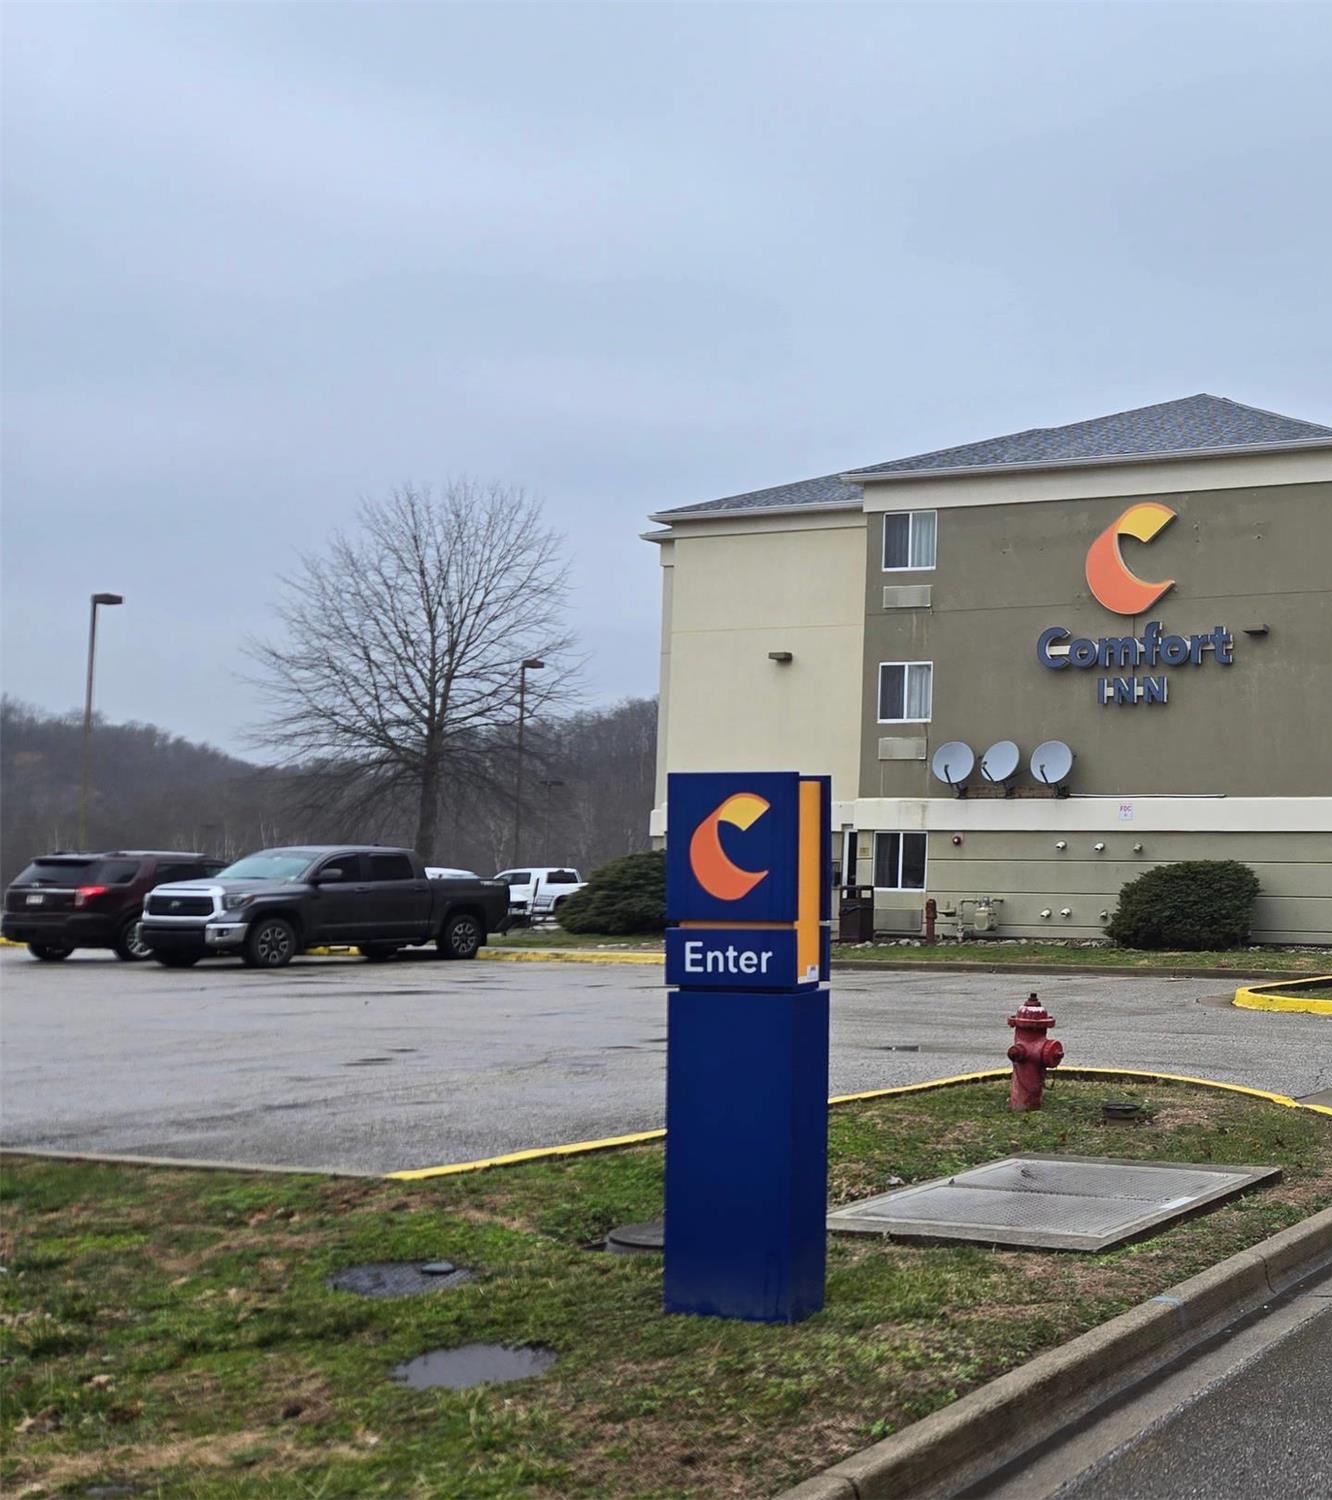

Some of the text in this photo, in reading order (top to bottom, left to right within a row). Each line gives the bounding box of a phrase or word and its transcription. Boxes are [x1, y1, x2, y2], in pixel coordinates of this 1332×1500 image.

[1037, 621, 1234, 670] Comfort
[1097, 676, 1168, 704] INN
[684, 941, 773, 974] Enter
